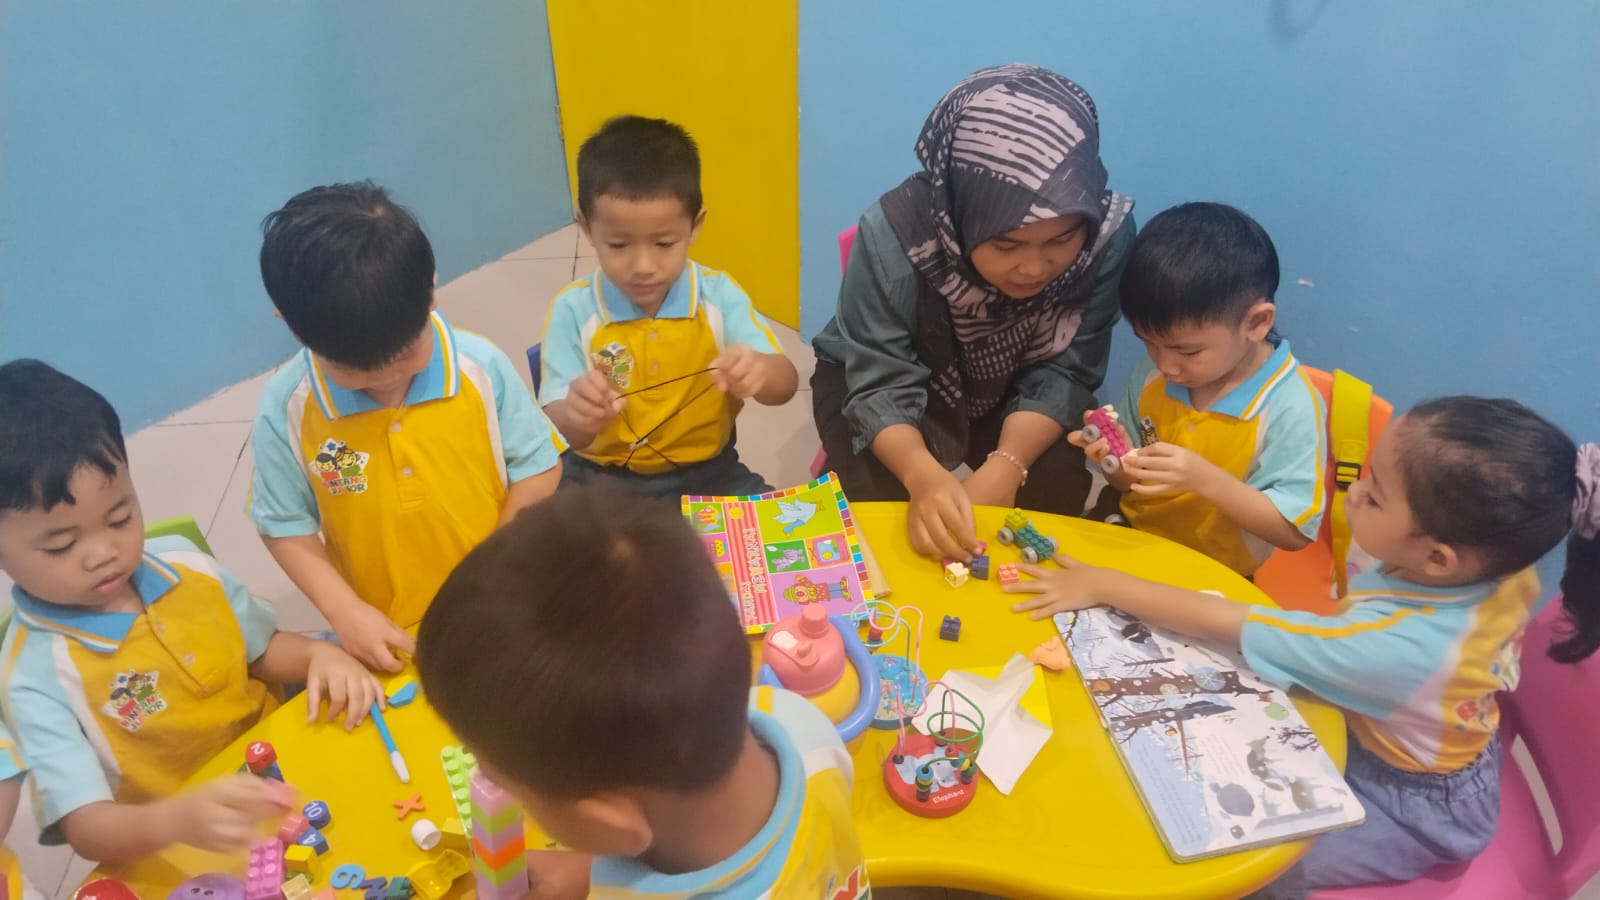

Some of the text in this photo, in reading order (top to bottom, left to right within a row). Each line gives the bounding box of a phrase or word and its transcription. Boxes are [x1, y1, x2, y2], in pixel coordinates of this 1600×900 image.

[250, 742, 265, 755] 2
[933, 789, 965, 803] Elephant
[304, 802, 323, 818] 10
[301, 833, 317, 845] 4
